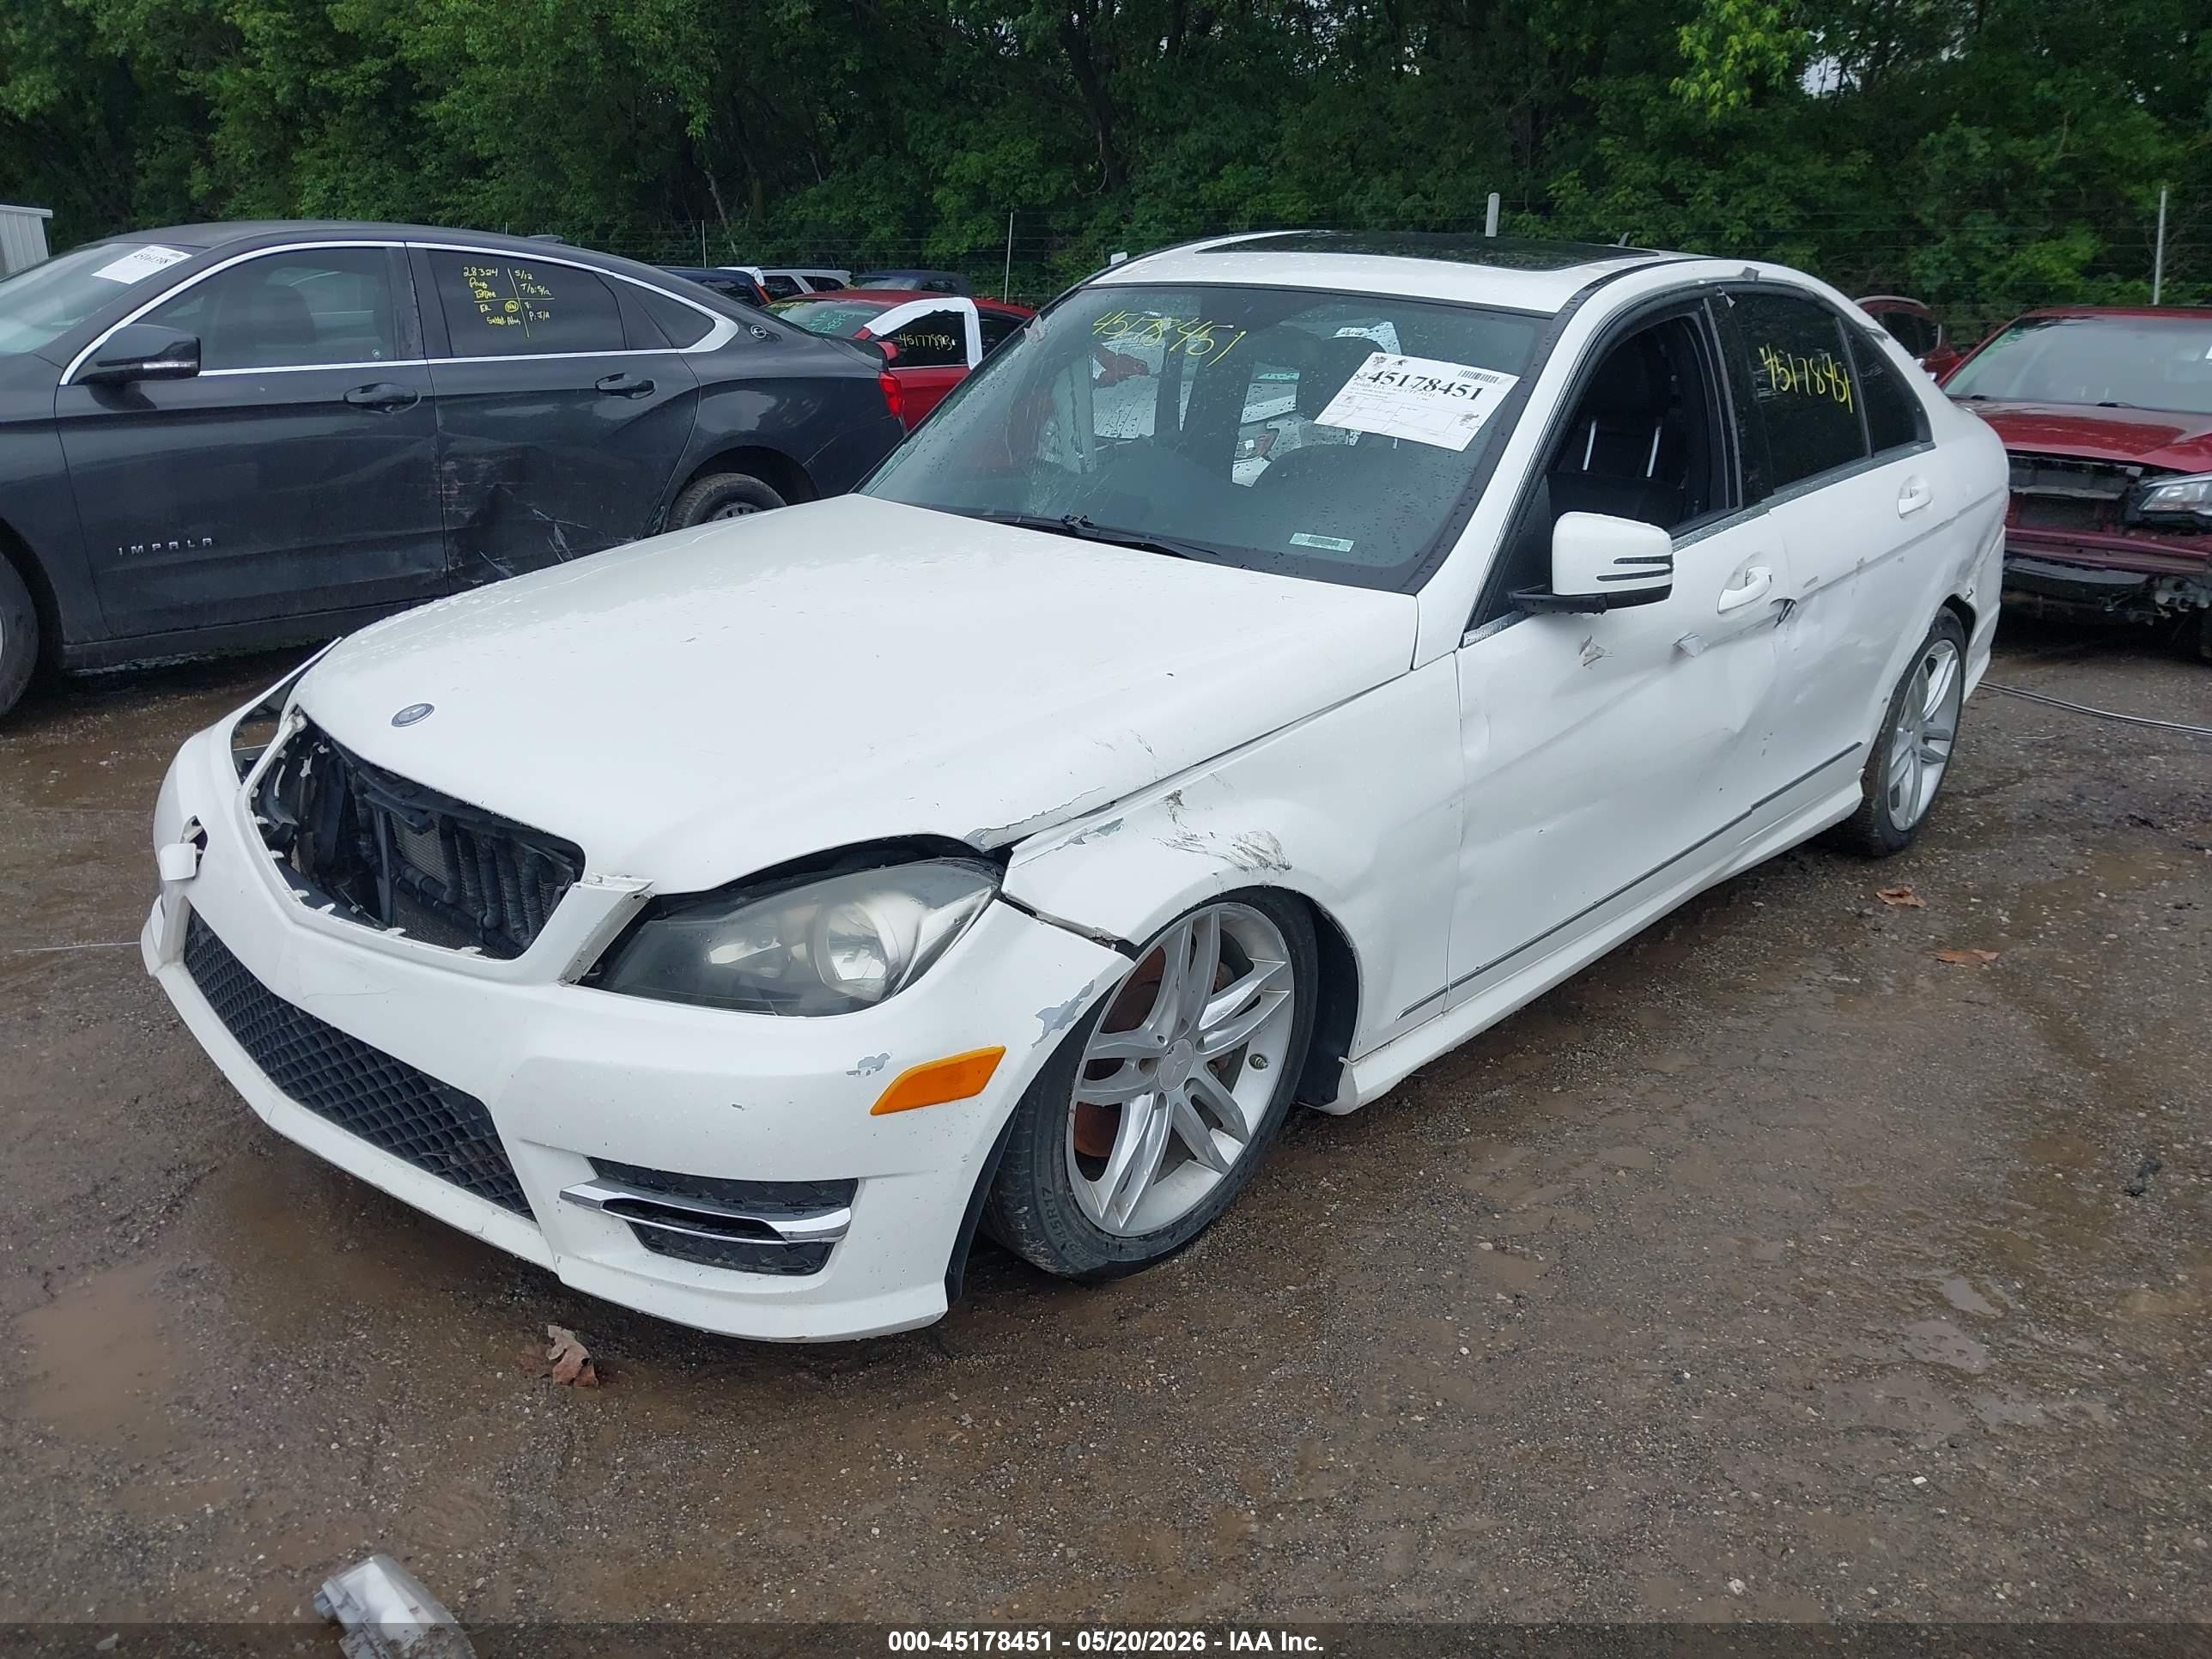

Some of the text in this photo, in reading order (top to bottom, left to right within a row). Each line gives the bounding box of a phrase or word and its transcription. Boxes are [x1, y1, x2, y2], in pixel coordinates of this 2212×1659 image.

[464, 267, 498, 277] 28324
[1092, 310, 1247, 368] 45178451
[1367, 370, 1486, 400] 45178451
[1759, 343, 1853, 413] 45178451
[118, 538, 212, 556] IMPALA
